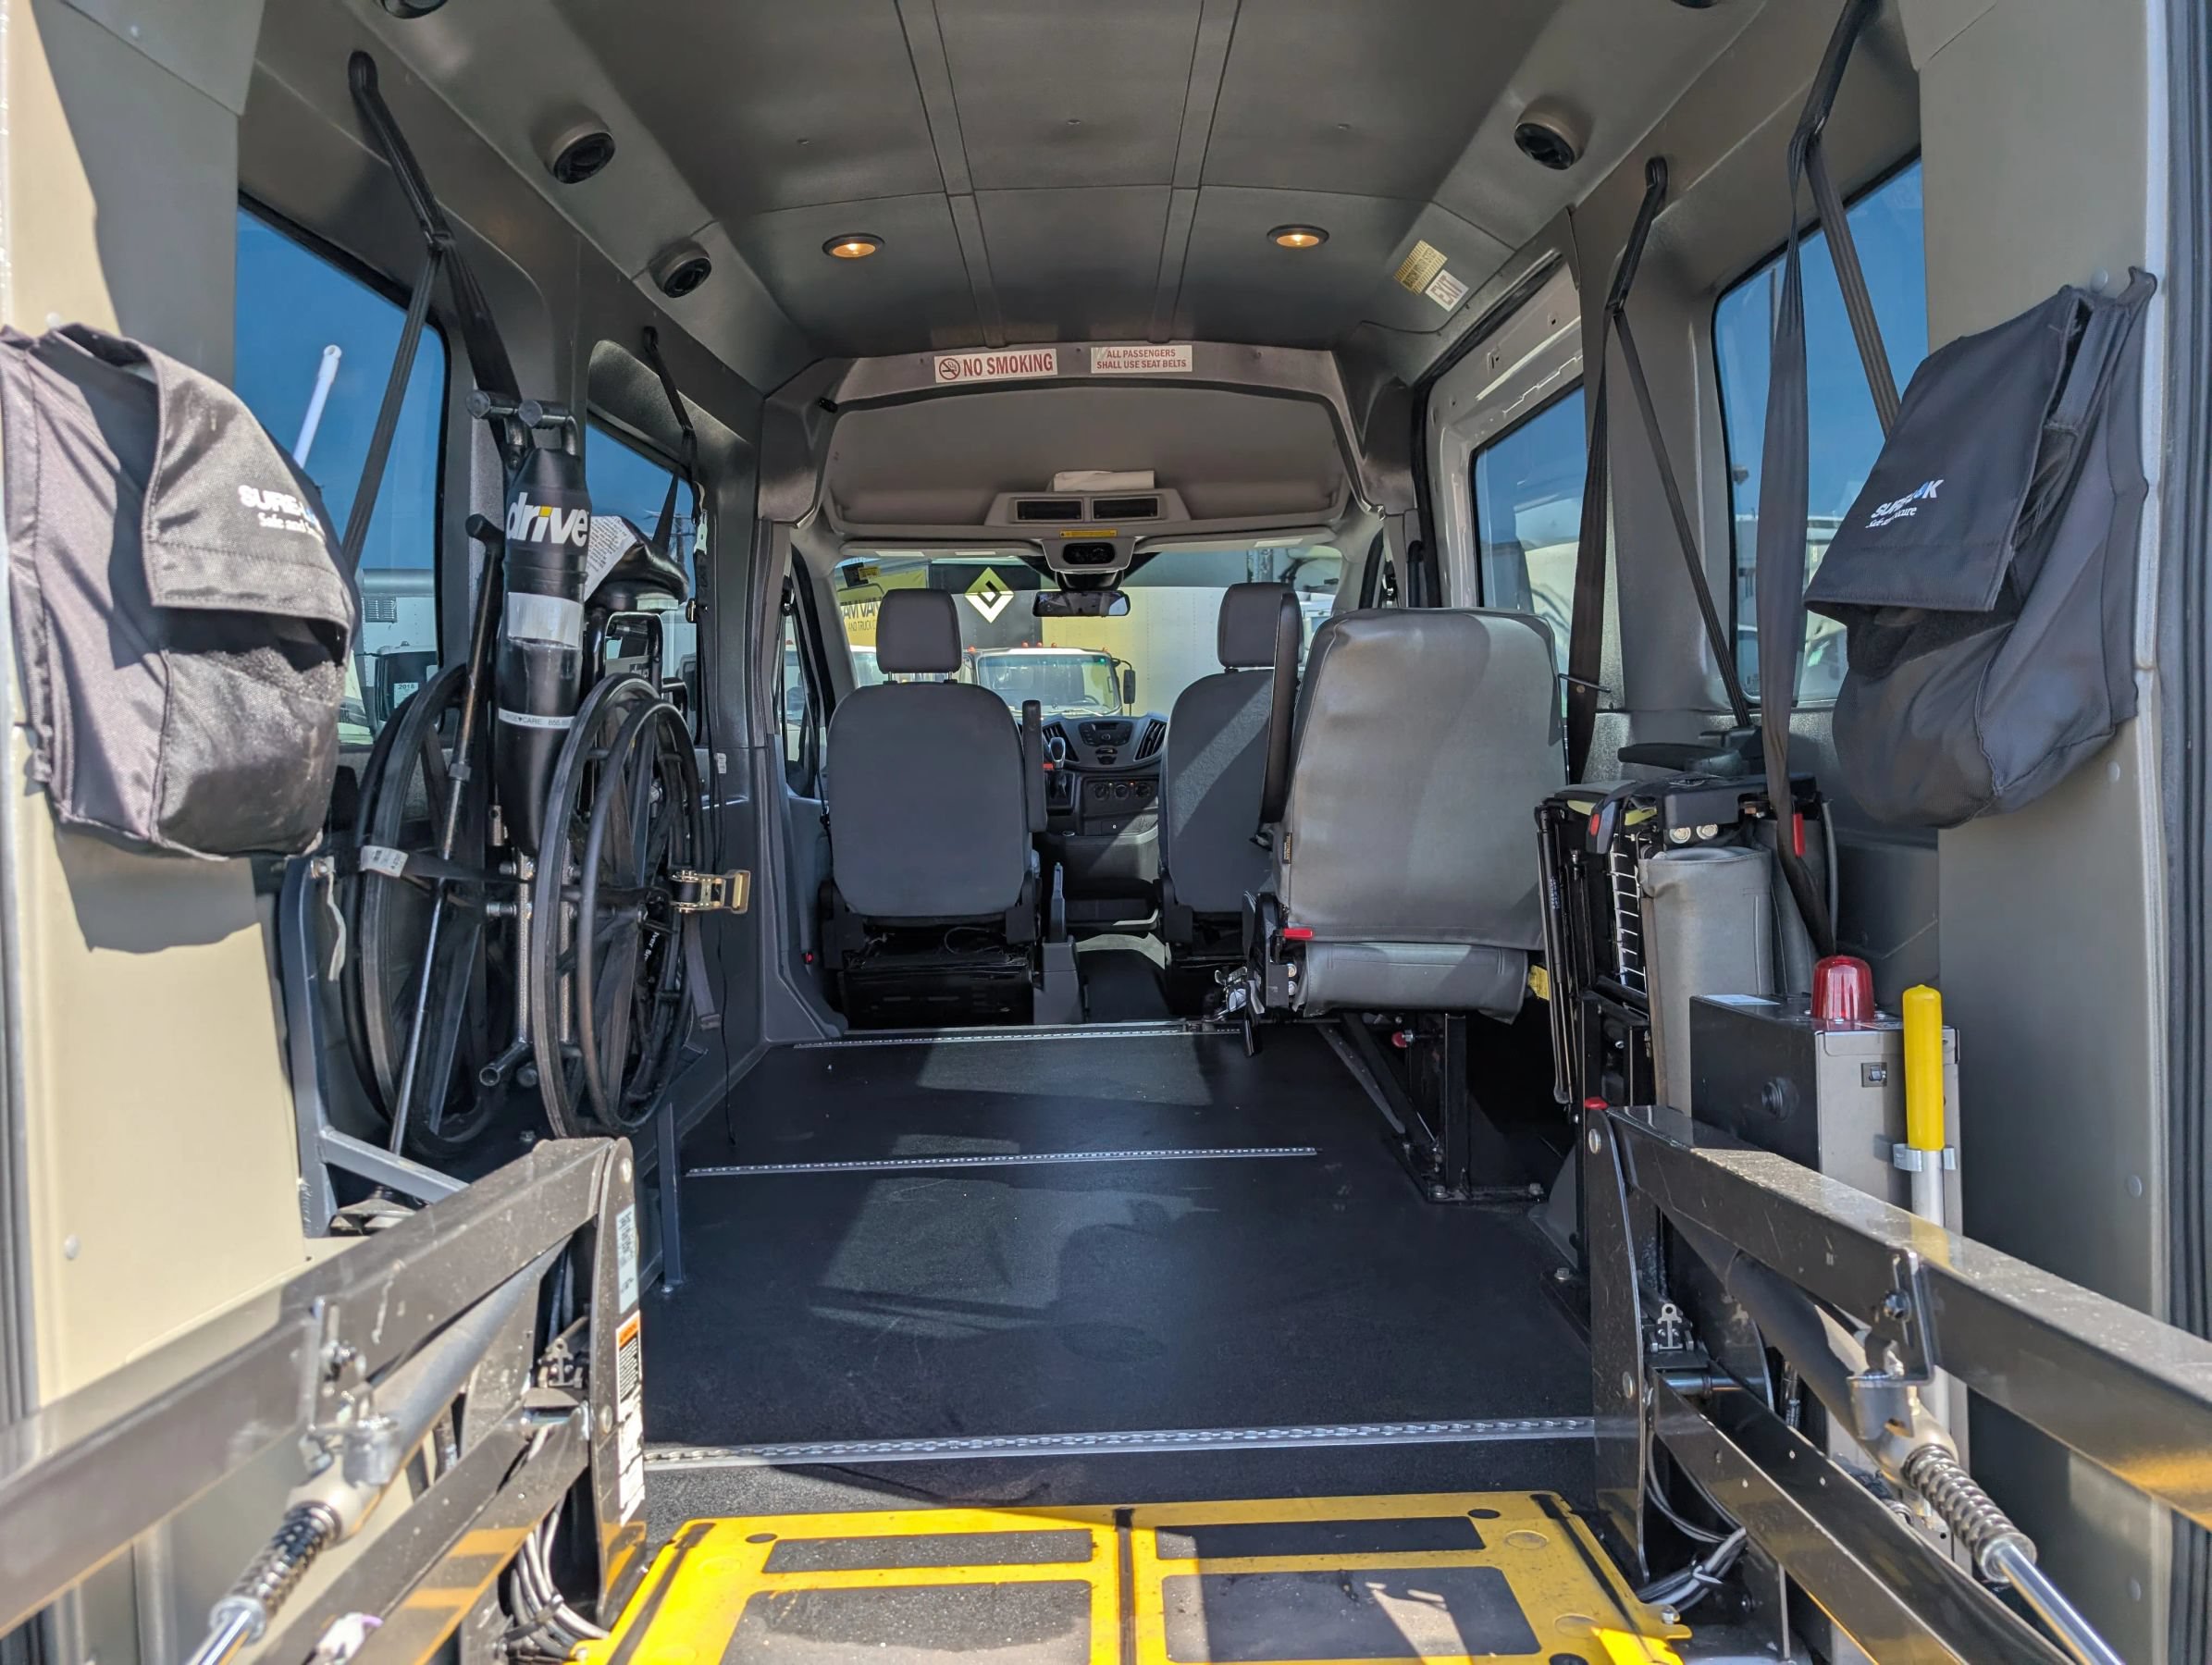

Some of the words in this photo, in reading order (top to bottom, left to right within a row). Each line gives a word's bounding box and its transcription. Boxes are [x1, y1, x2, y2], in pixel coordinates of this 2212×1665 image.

[1430, 274, 1463, 306] EXIT
[963, 358, 983, 377] NO
[986, 352, 1054, 376] SMOKING
[1096, 361, 1122, 370] SHALL
[1123, 360, 1140, 369] USE
[1141, 360, 1161, 369] SEAT
[1162, 359, 1187, 368] BELTS
[1106, 350, 1121, 359] ALL
[1123, 349, 1176, 359] PASSENGERS
[506, 491, 588, 548] drive
